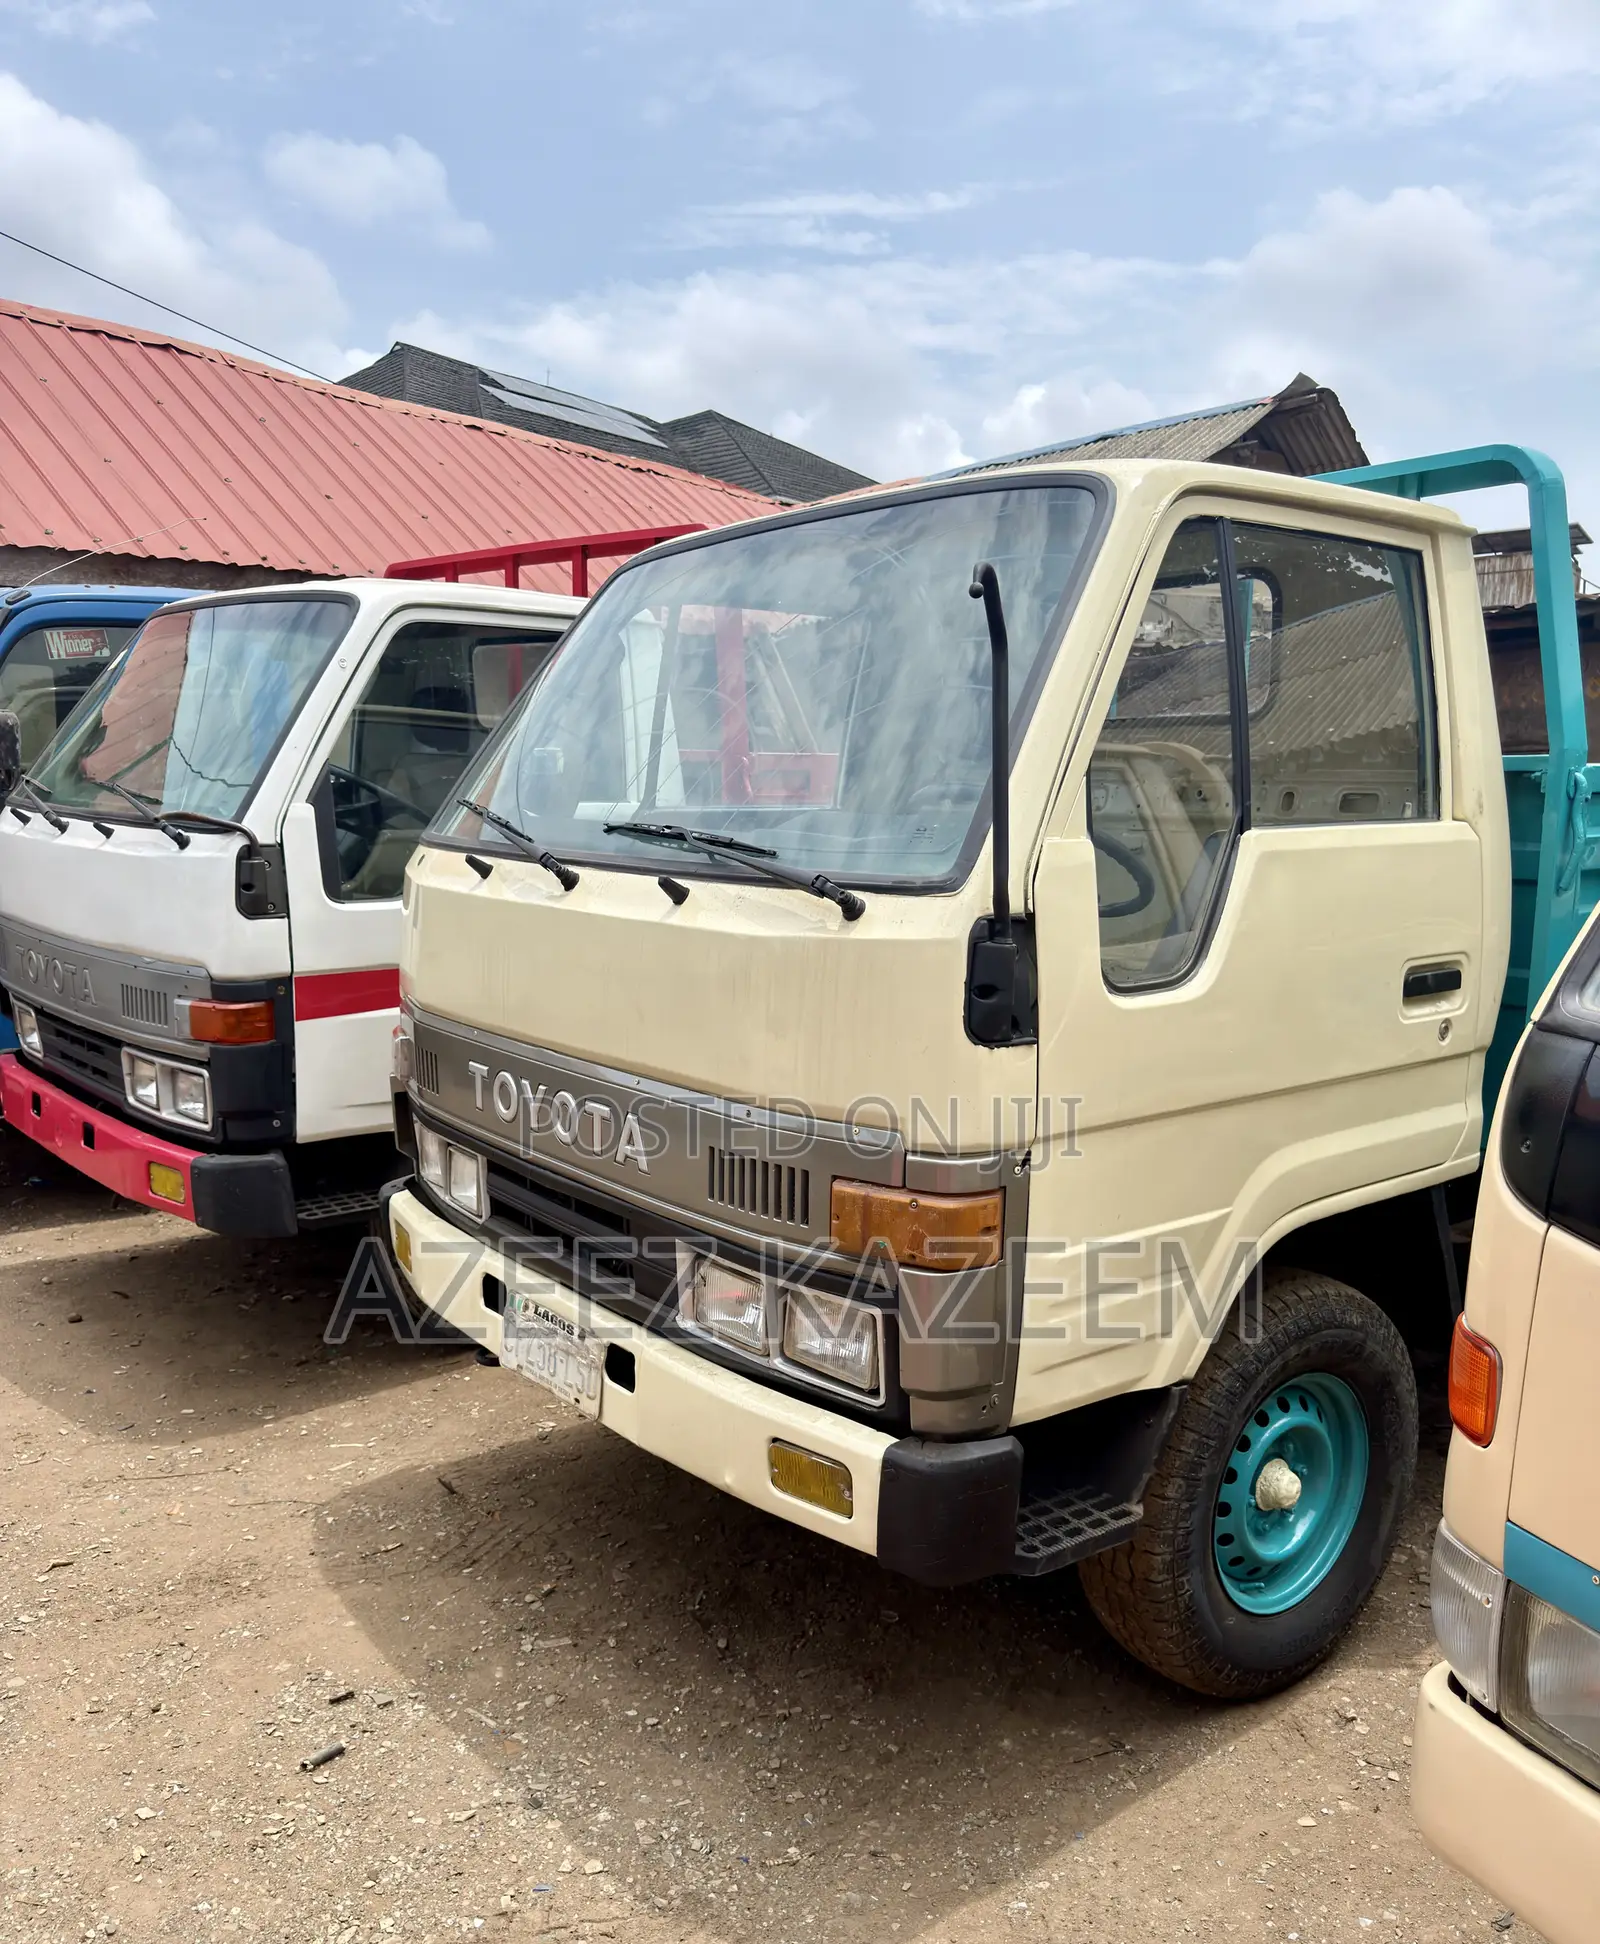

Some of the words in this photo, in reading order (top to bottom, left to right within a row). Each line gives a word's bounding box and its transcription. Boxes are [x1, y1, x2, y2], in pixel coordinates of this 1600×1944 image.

[45, 631, 94, 660] Winner
[15, 944, 98, 1007] TOYOTA
[468, 1059, 650, 1175] TOYOTA
[533, 1304, 575, 1337] LAGOS
